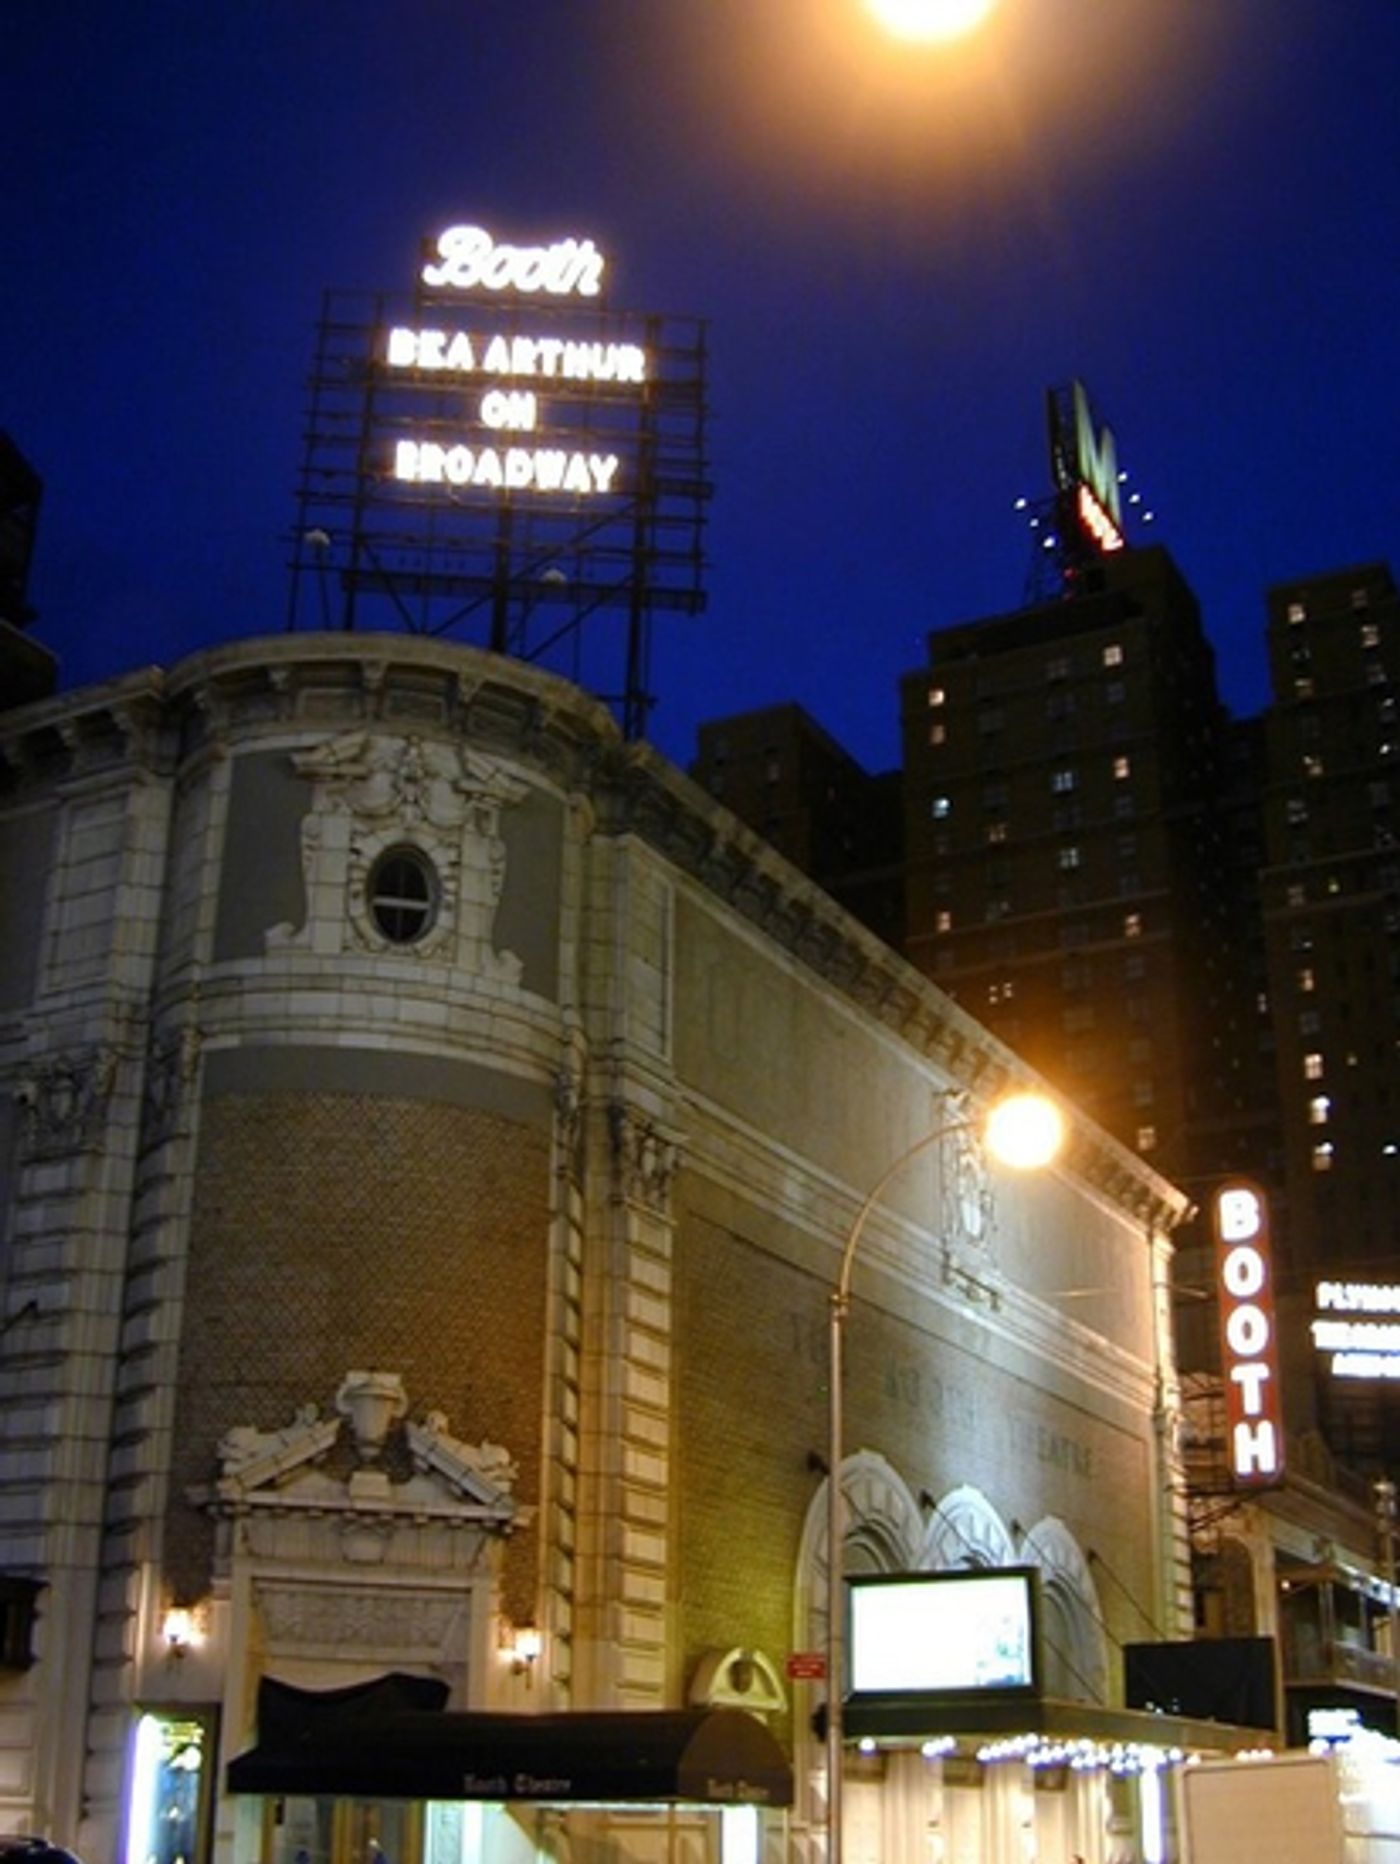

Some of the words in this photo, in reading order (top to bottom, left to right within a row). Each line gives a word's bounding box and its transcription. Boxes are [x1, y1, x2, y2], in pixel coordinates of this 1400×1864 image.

[422, 224, 606, 297] Booth
[387, 327, 475, 374] BEA
[482, 334, 647, 384] ARTHUR
[480, 388, 538, 432] ON
[395, 439, 620, 495] BROADWAY
[1219, 1189, 1277, 1475] BOOTH
